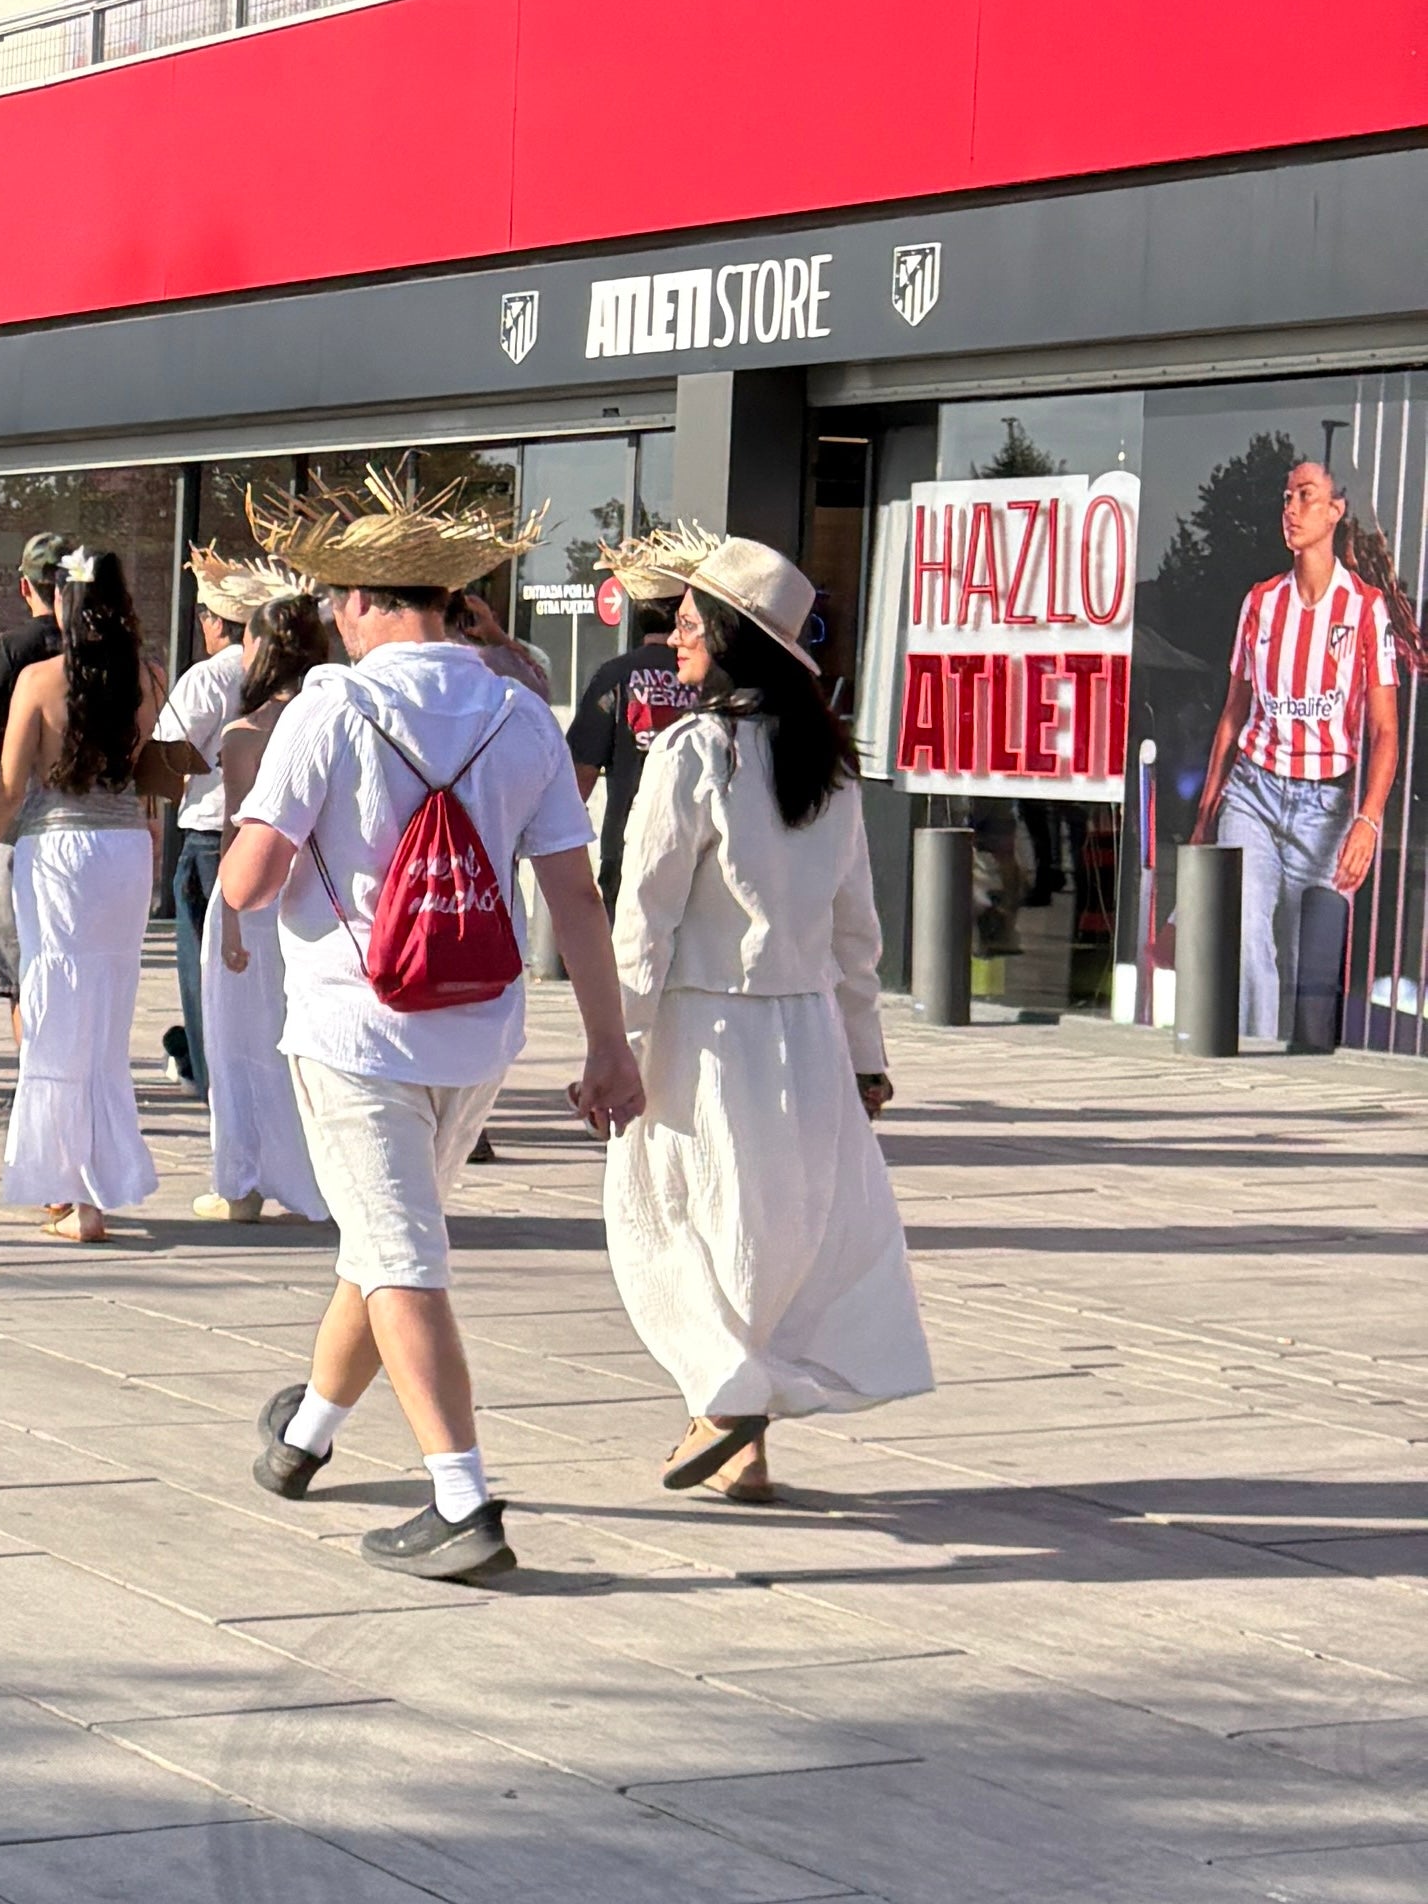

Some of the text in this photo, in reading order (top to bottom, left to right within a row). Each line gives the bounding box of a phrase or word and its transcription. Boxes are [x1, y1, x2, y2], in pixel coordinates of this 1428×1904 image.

[584, 253, 833, 359] ATLETI STORE
[563, 584, 582, 599] POR
[582, 584, 596, 599] LA
[912, 494, 1127, 625] HAZLO
[536, 600, 560, 615] OTRA
[897, 653, 1130, 776] ATLETI
[1264, 694, 1333, 718] Herbalife
